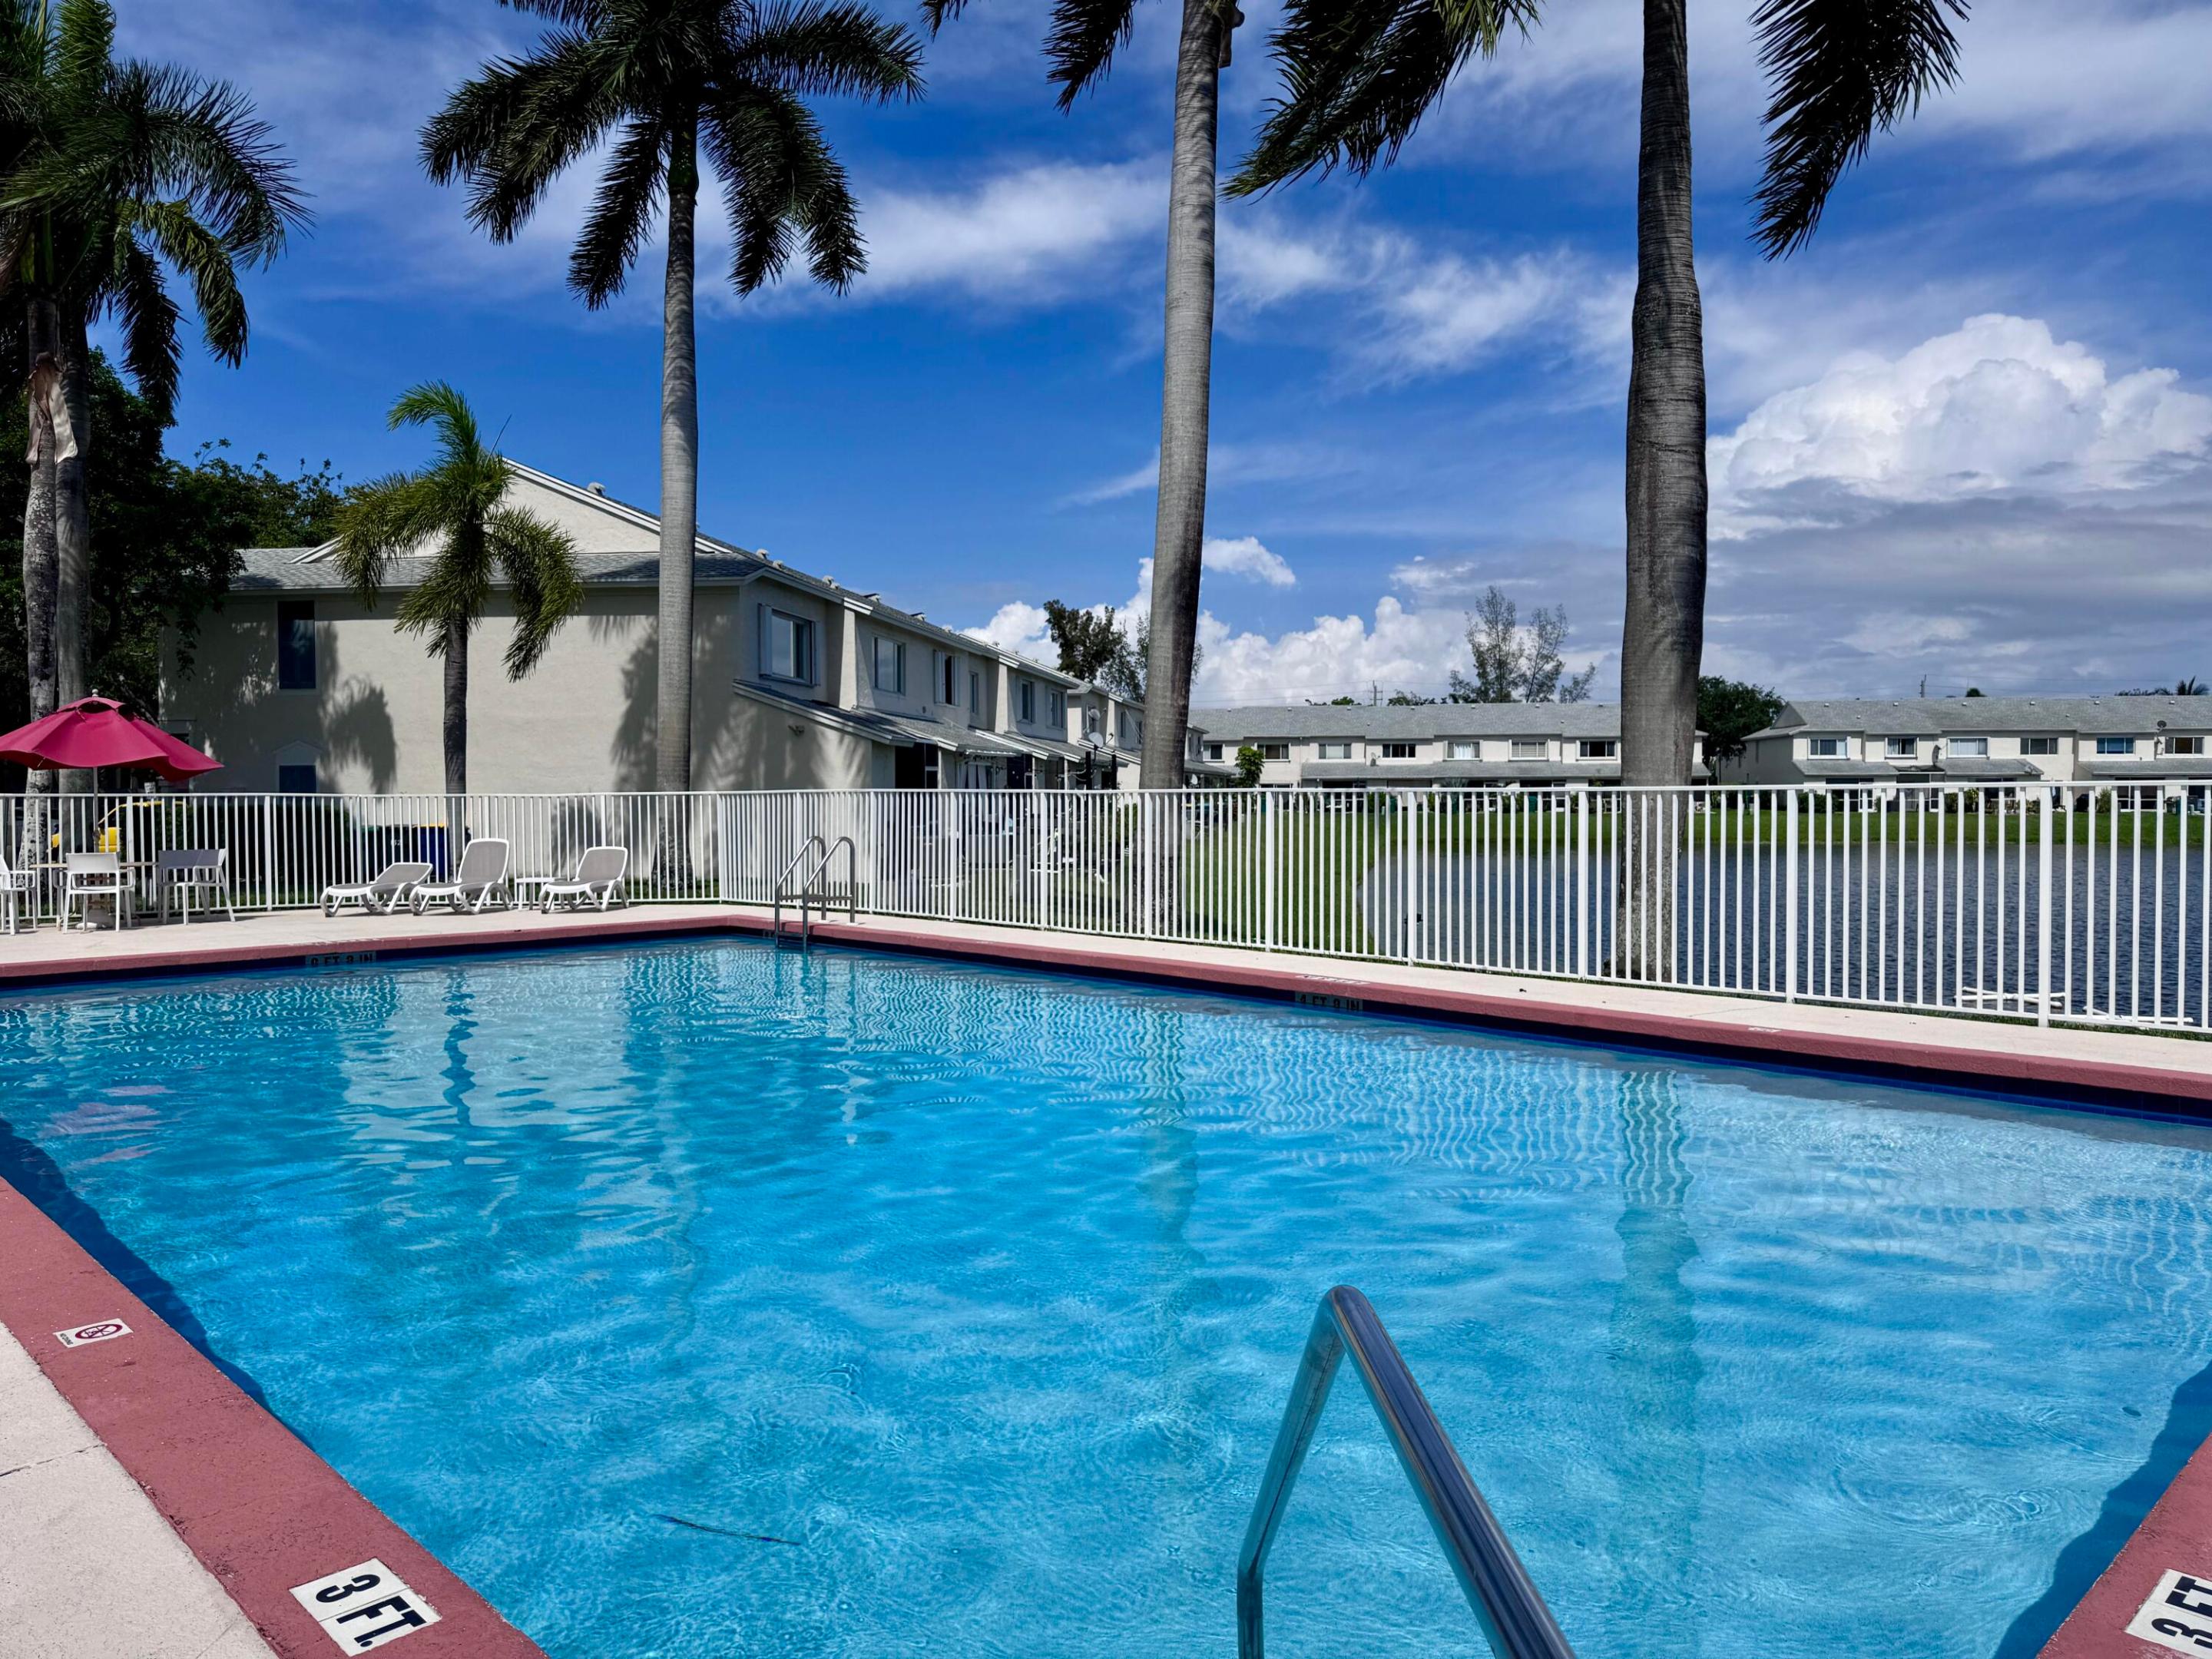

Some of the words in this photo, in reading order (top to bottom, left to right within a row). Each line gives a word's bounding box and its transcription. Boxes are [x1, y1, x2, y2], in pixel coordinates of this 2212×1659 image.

[325, 956, 339, 965] FT
[359, 953, 373, 963] IN
[1313, 995, 1327, 1006] FT
[1346, 999, 1359, 1011] IN
[316, 1574, 381, 1603] 3
[2151, 1618, 2212, 1649] 3
